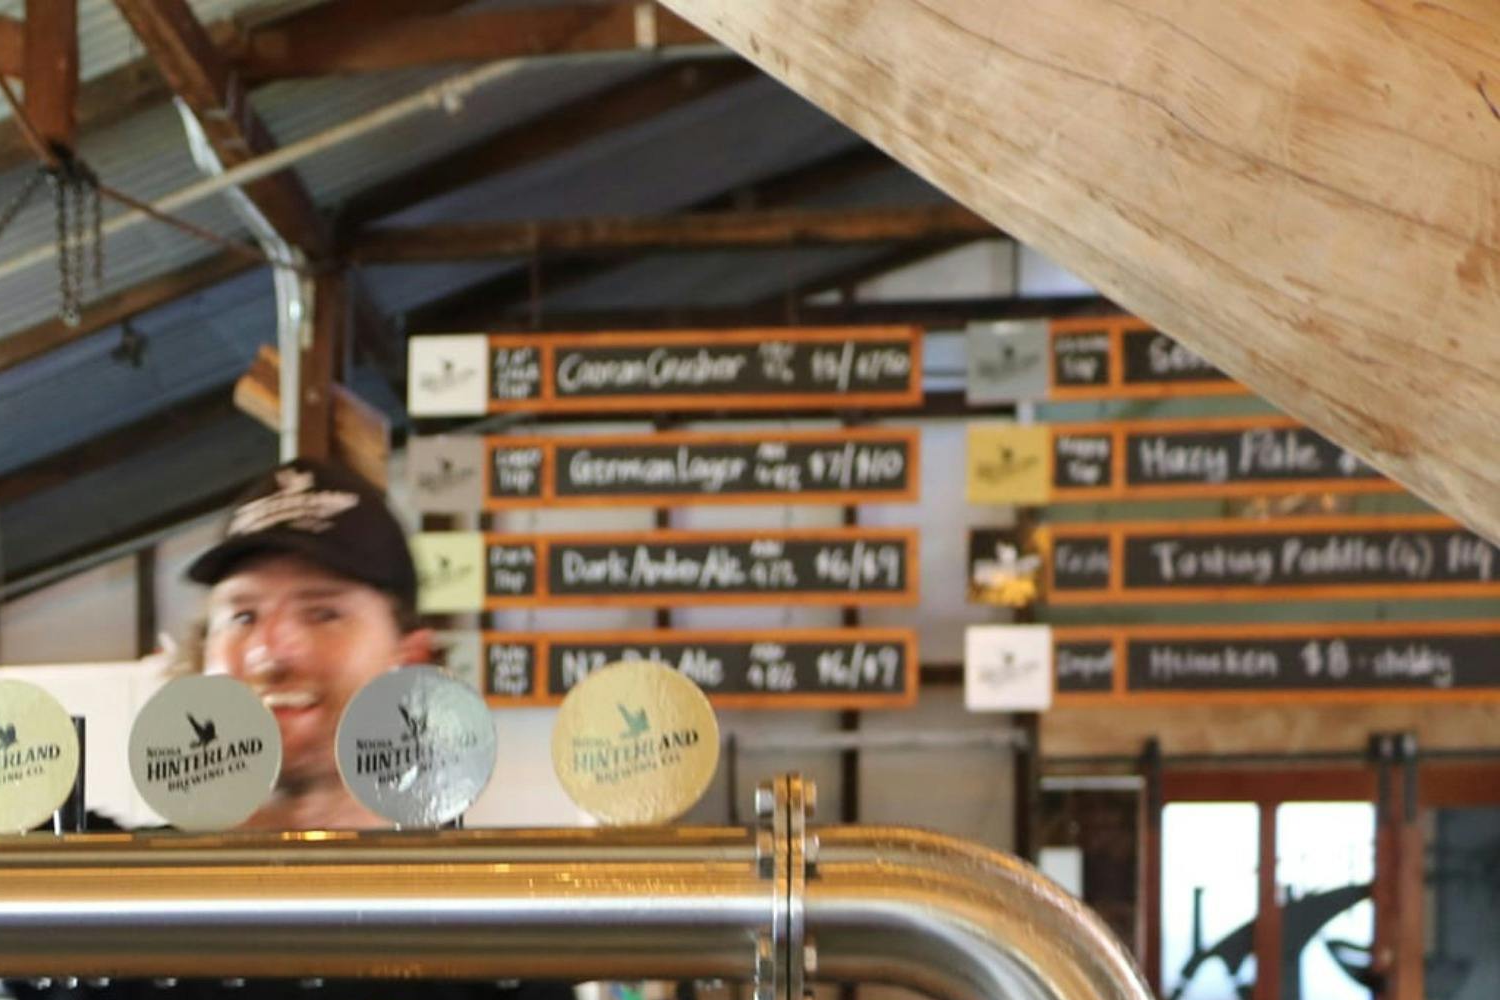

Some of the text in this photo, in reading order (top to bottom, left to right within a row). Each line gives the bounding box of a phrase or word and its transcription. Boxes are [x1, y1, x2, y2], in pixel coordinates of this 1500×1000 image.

[562, 549, 629, 586] Dark
[147, 737, 263, 783] HINTERLAND
[574, 730, 699, 774] HINTERLAND
